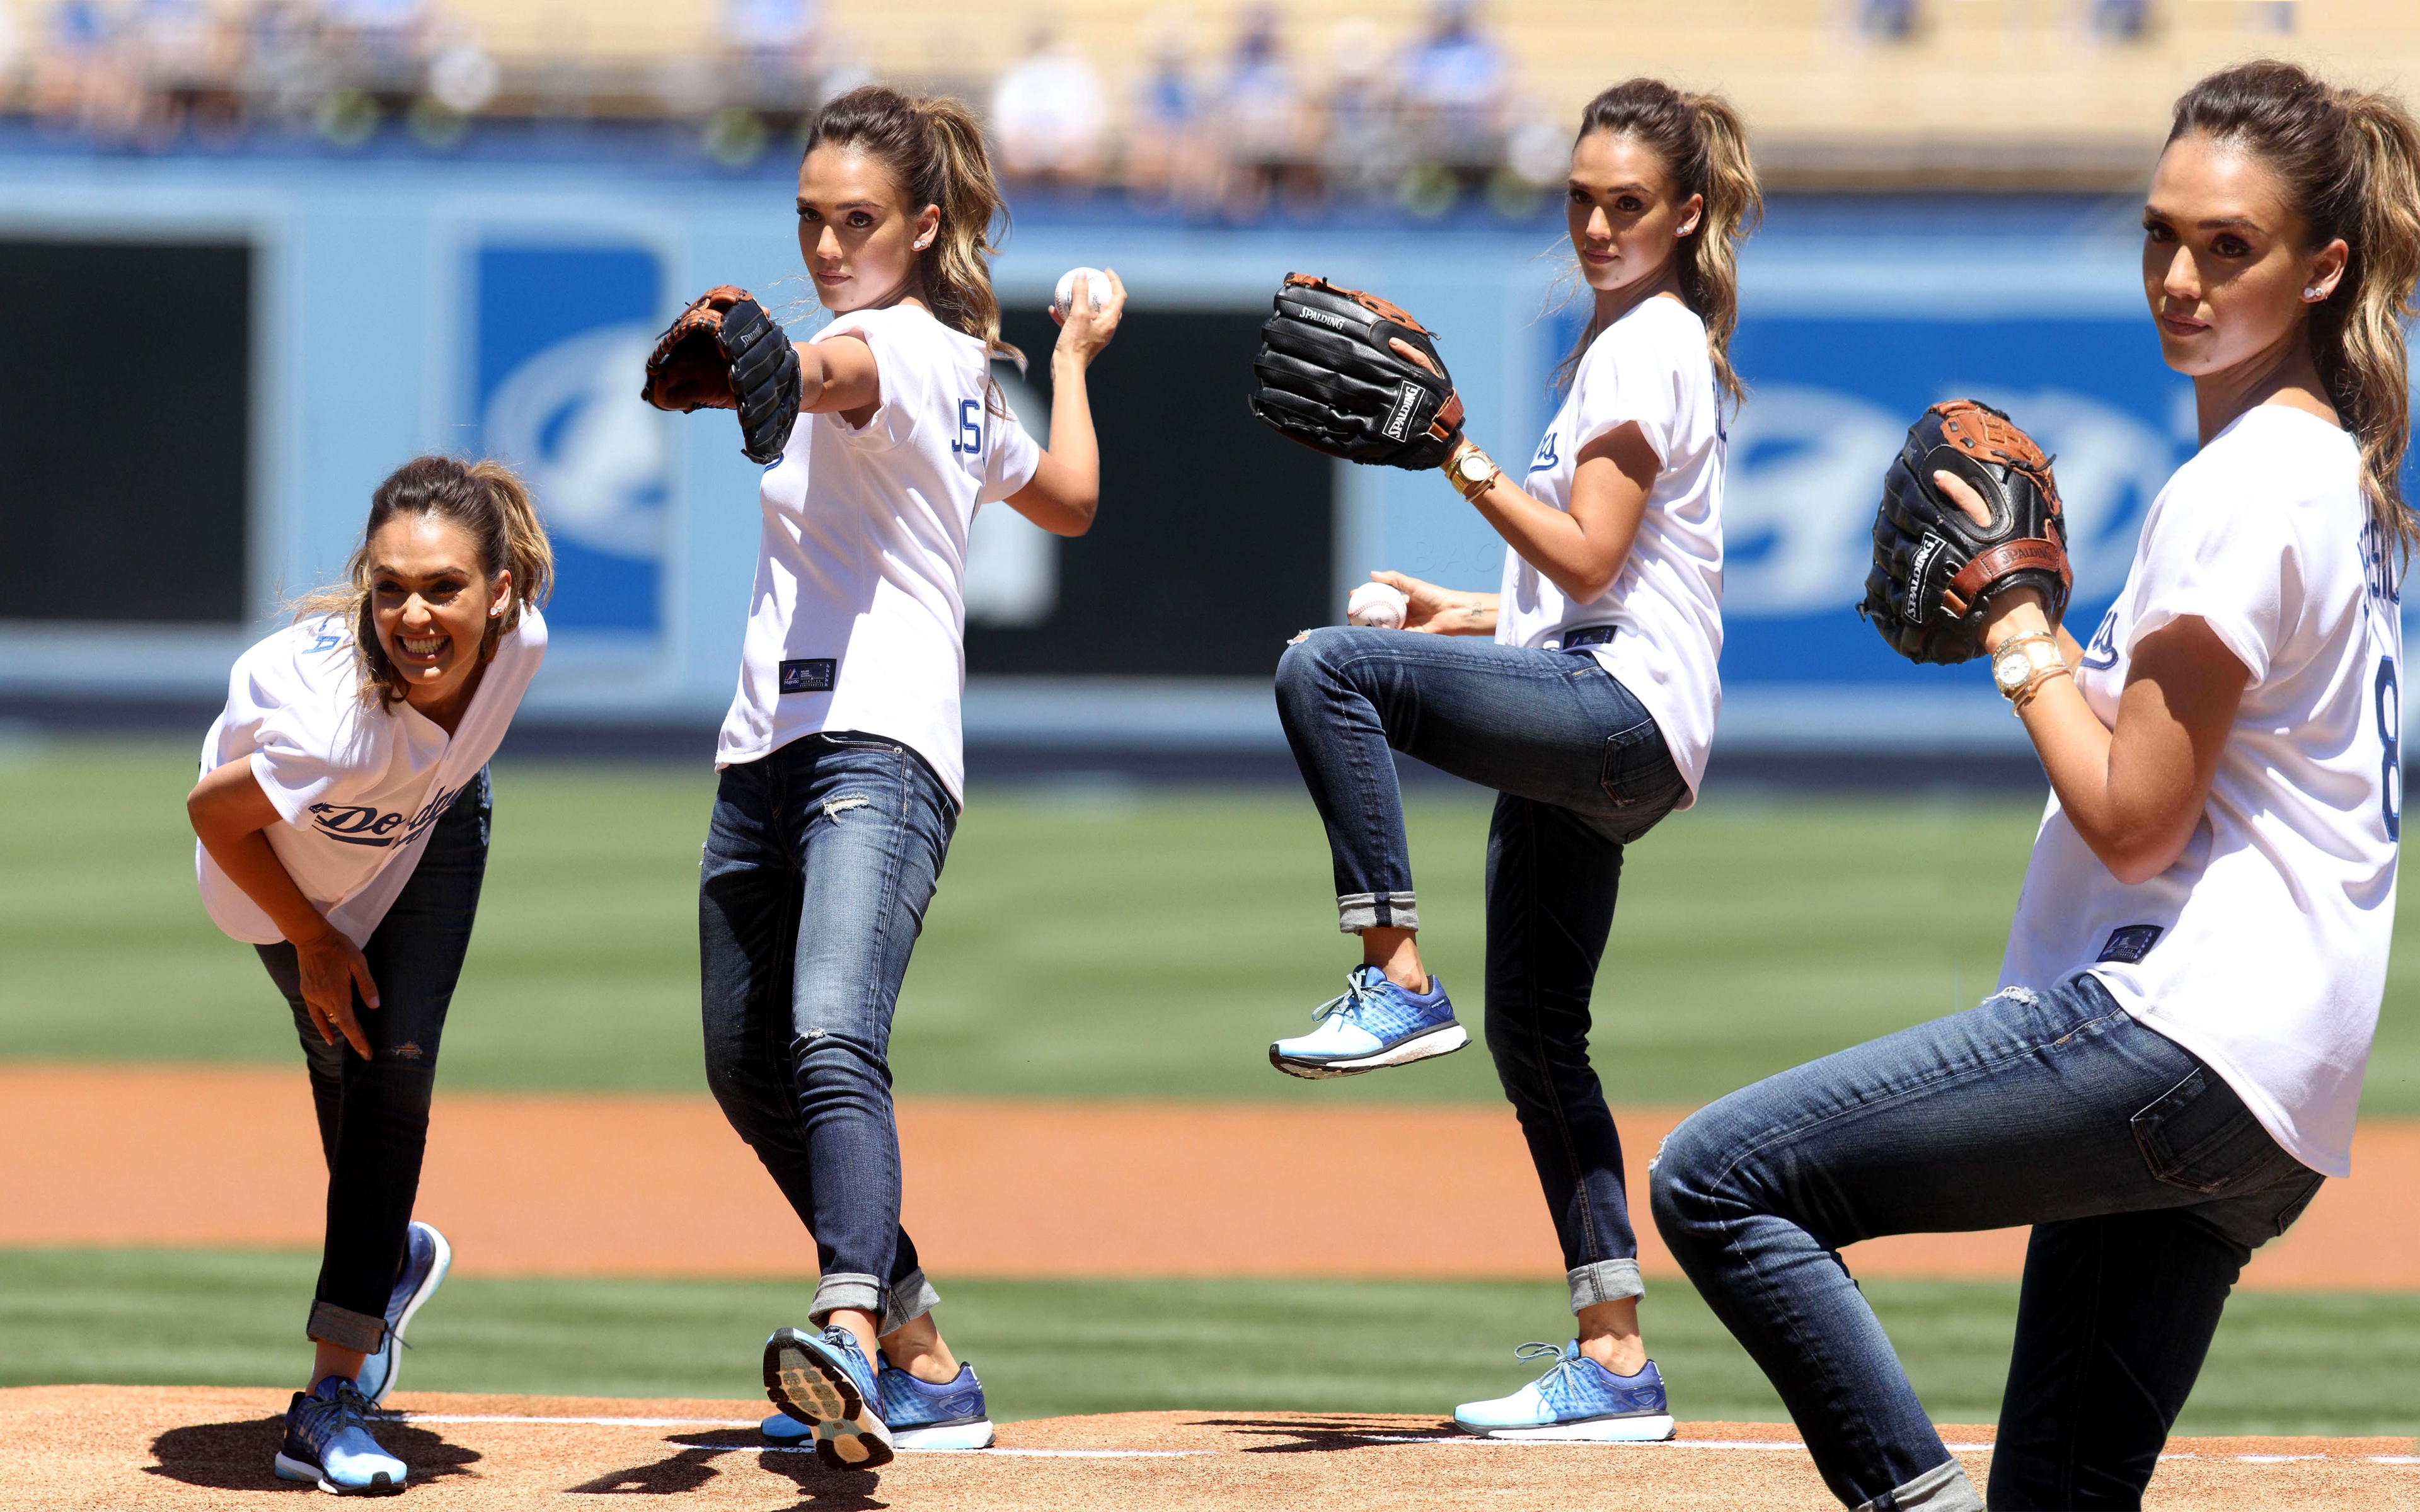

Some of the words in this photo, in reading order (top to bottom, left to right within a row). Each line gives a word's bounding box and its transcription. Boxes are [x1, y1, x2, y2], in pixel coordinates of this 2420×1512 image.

[740, 323, 763, 348] SPALDING
[1299, 306, 1345, 331] SPALDING
[1388, 386, 1419, 438] SPALDING
[1907, 539, 1936, 618] SPALDING
[2375, 655, 2400, 842] 8
